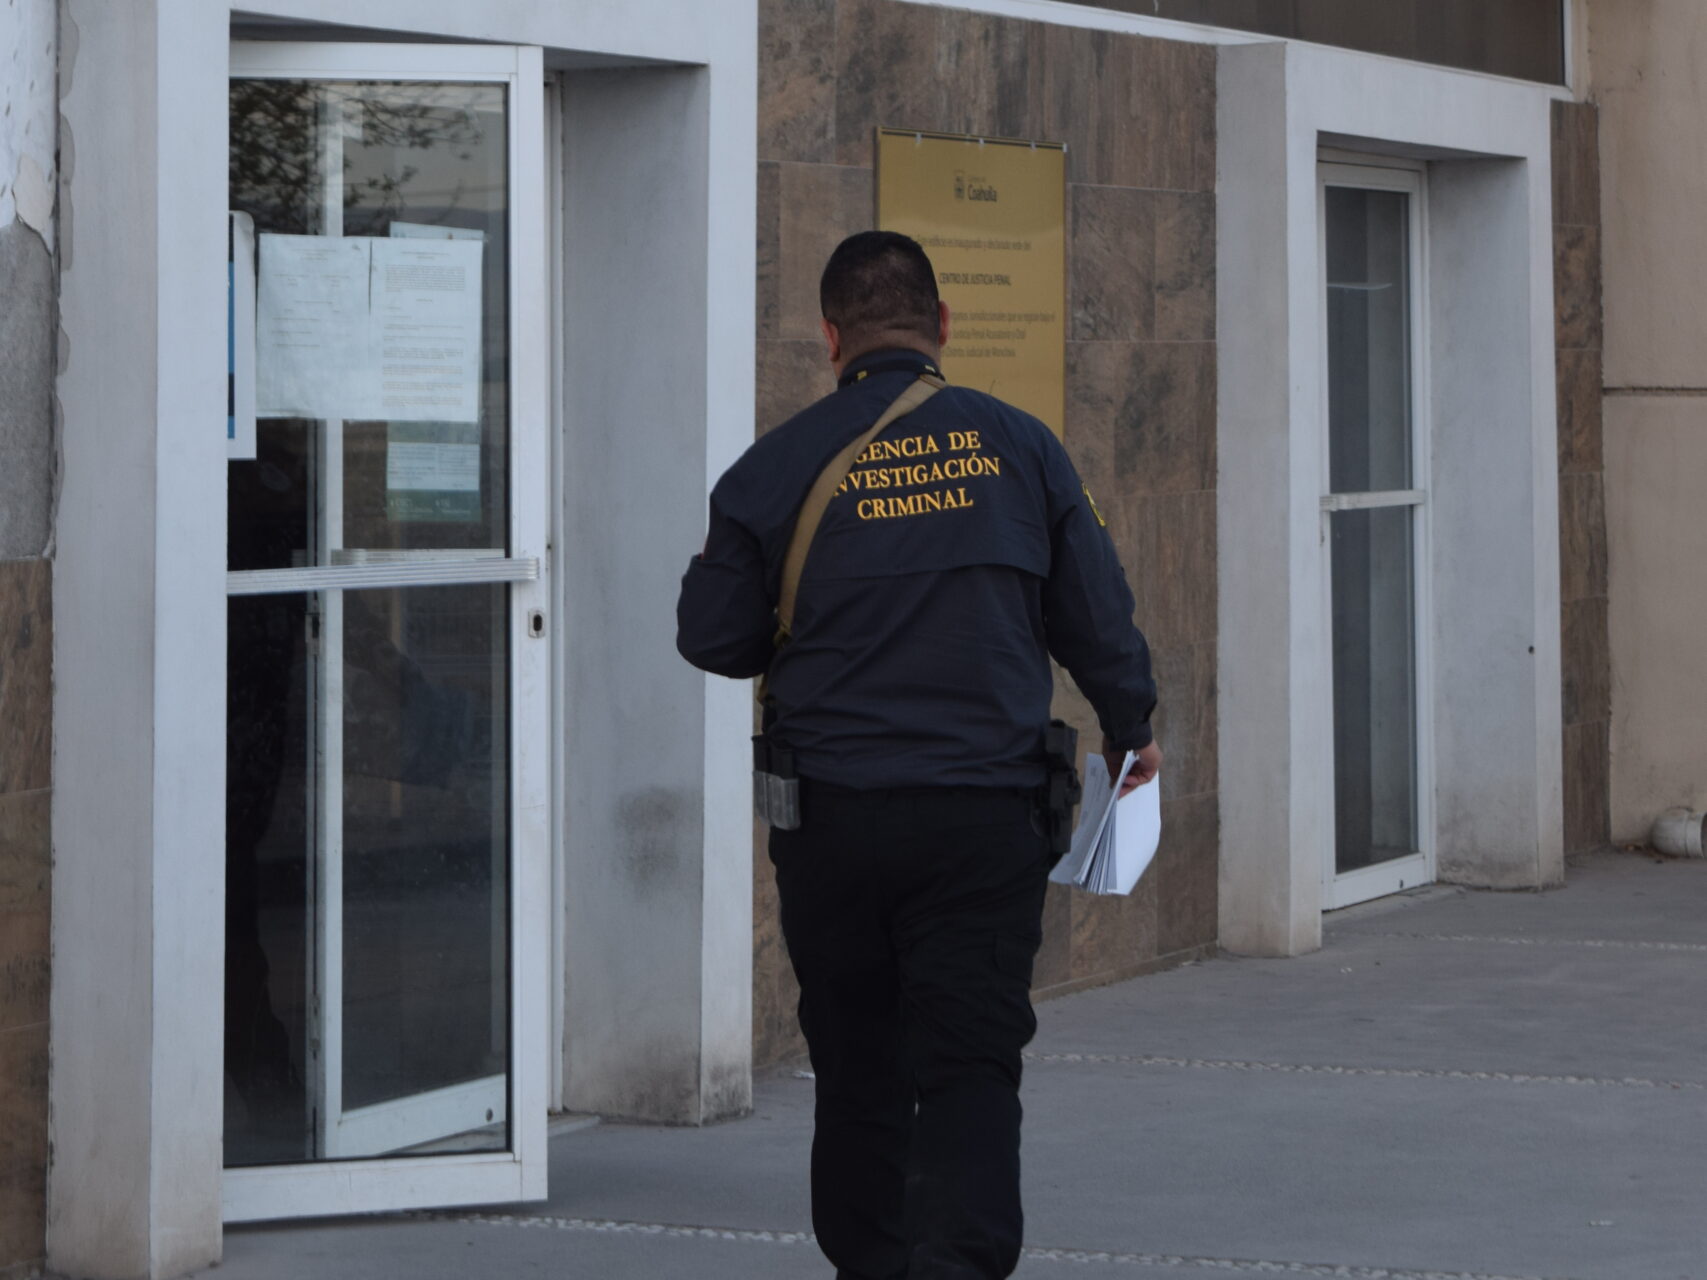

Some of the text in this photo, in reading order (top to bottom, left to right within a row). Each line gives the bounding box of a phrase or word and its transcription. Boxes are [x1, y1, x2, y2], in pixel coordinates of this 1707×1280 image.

[855, 431, 982, 464] ENCIA DE
[833, 452, 1000, 496] VESTIGACIÓN
[857, 487, 974, 521] CRIMINAL
